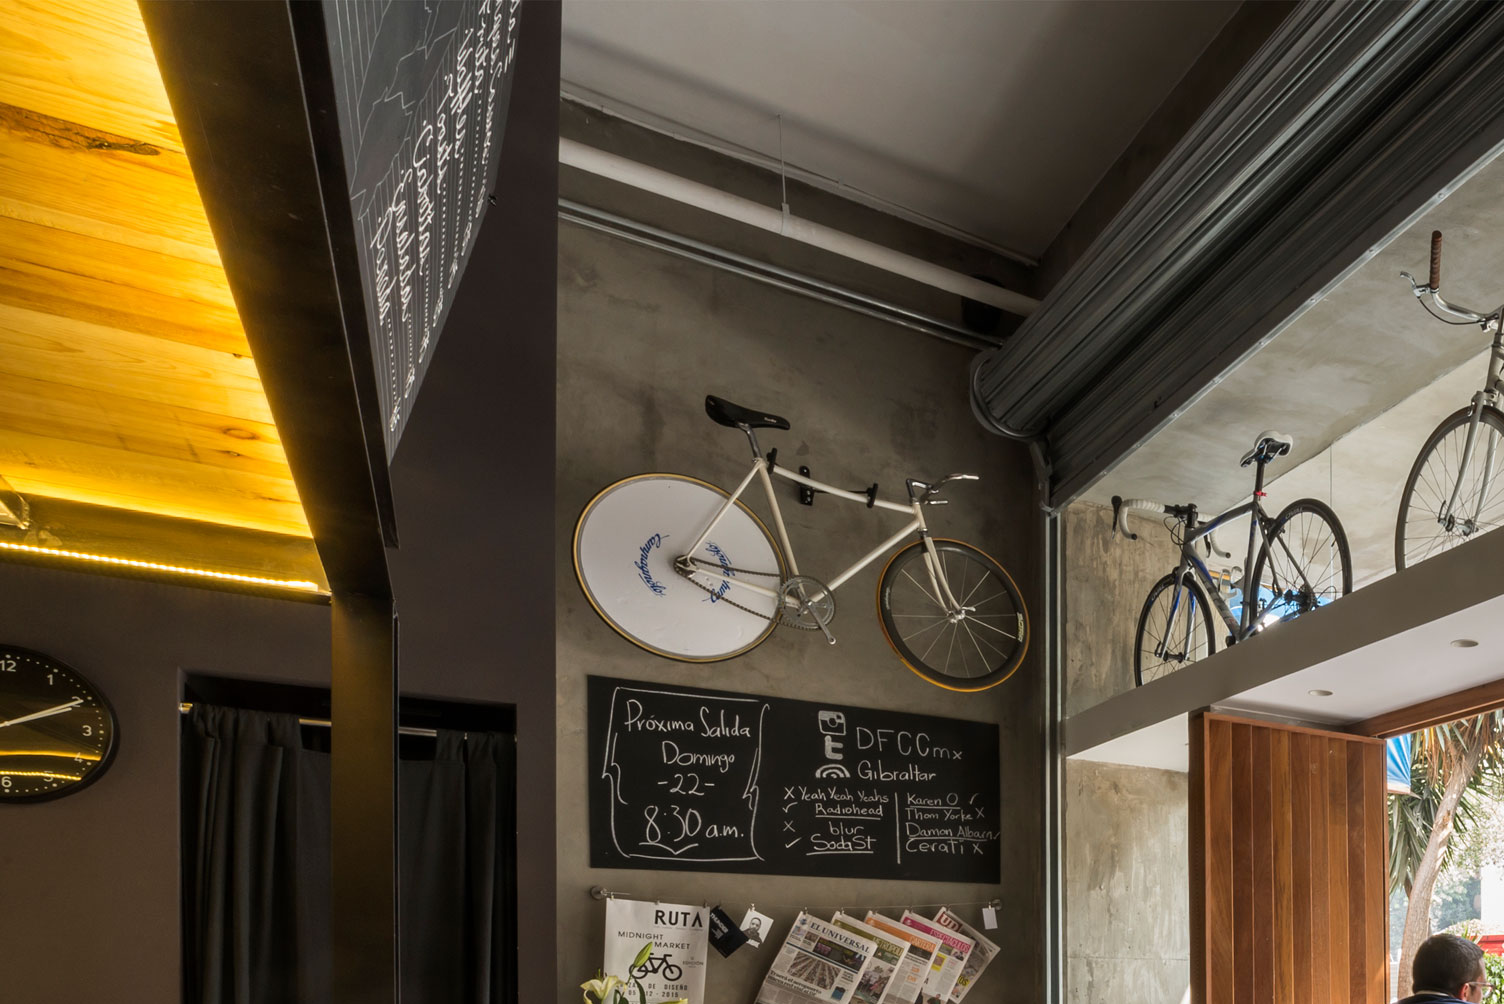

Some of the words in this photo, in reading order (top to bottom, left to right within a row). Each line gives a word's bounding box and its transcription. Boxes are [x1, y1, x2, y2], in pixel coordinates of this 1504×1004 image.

[450, 29, 474, 159] Waffles
[437, 74, 454, 194] Toasts
[634, 533, 670, 597] Campagnolo
[47, 674, 54, 686] 1
[624, 699, 695, 733] Próxima
[700, 706, 752, 738] Salida
[82, 725, 93, 737] 3
[662, 740, 736, 774] Domingo
[857, 759, 937, 782] Gibraltar
[1, 776, 13, 788] 6
[798, 785, 827, 801] Yeah
[828, 786, 854, 802] Yeah
[857, 788, 889, 803] Yeahs
[907, 792, 942, 806] Karen
[815, 803, 883, 817] Radiohead
[905, 807, 939, 821] Thom
[943, 808, 974, 822] Yorke
[644, 805, 702, 844] 8:30
[706, 824, 745, 839] a.m.
[828, 821, 865, 836] blur
[905, 821, 953, 838] Damon
[654, 909, 703, 928] RUTA
[618, 931, 664, 940] MIDNIGHT
[810, 921, 821, 932] EL
[822, 926, 870, 954] UNIVERSAL
[654, 941, 691, 950] MARKET
